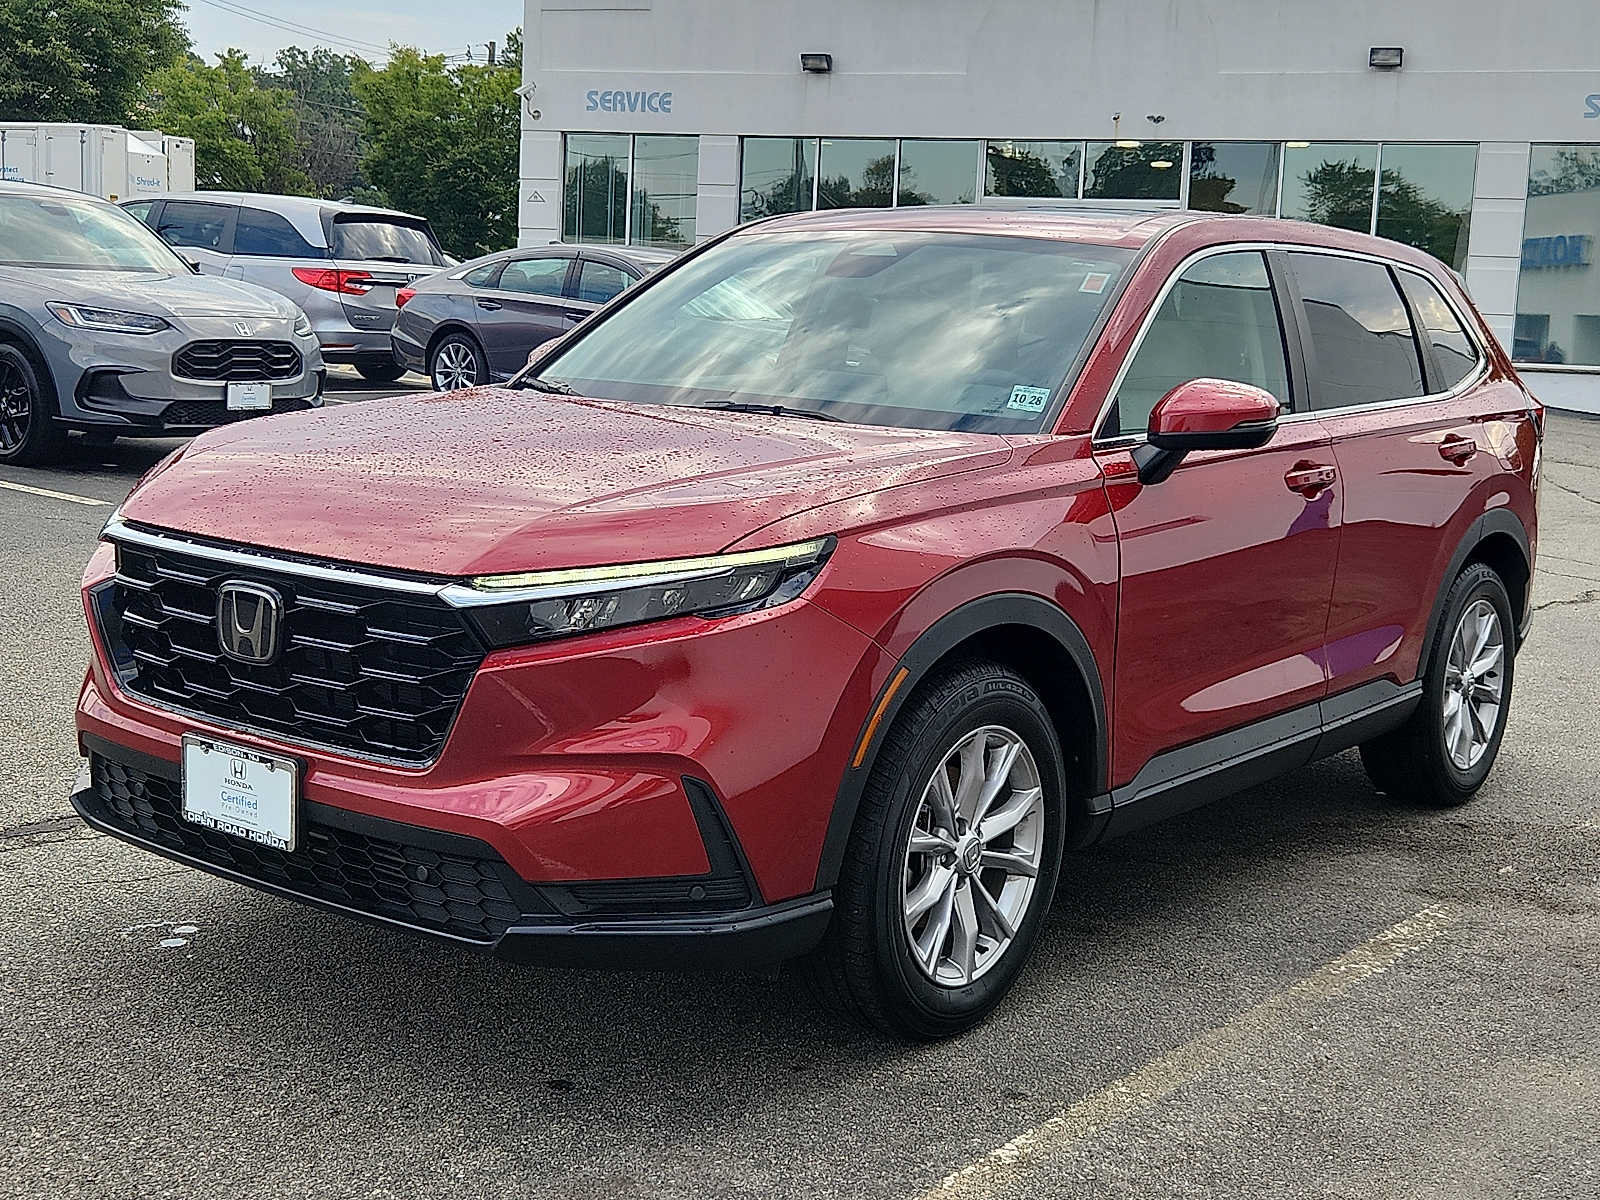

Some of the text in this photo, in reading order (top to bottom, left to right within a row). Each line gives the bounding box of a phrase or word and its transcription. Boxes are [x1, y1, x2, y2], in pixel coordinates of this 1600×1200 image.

[586, 90, 673, 114] SERVICE
[1013, 393, 1043, 406] 10 28
[224, 777, 254, 791] HONDA
[221, 791, 258, 810] Certified
[188, 812, 215, 828] OPEN
[216, 821, 247, 837] ROAD
[248, 830, 287, 851] HONDA
